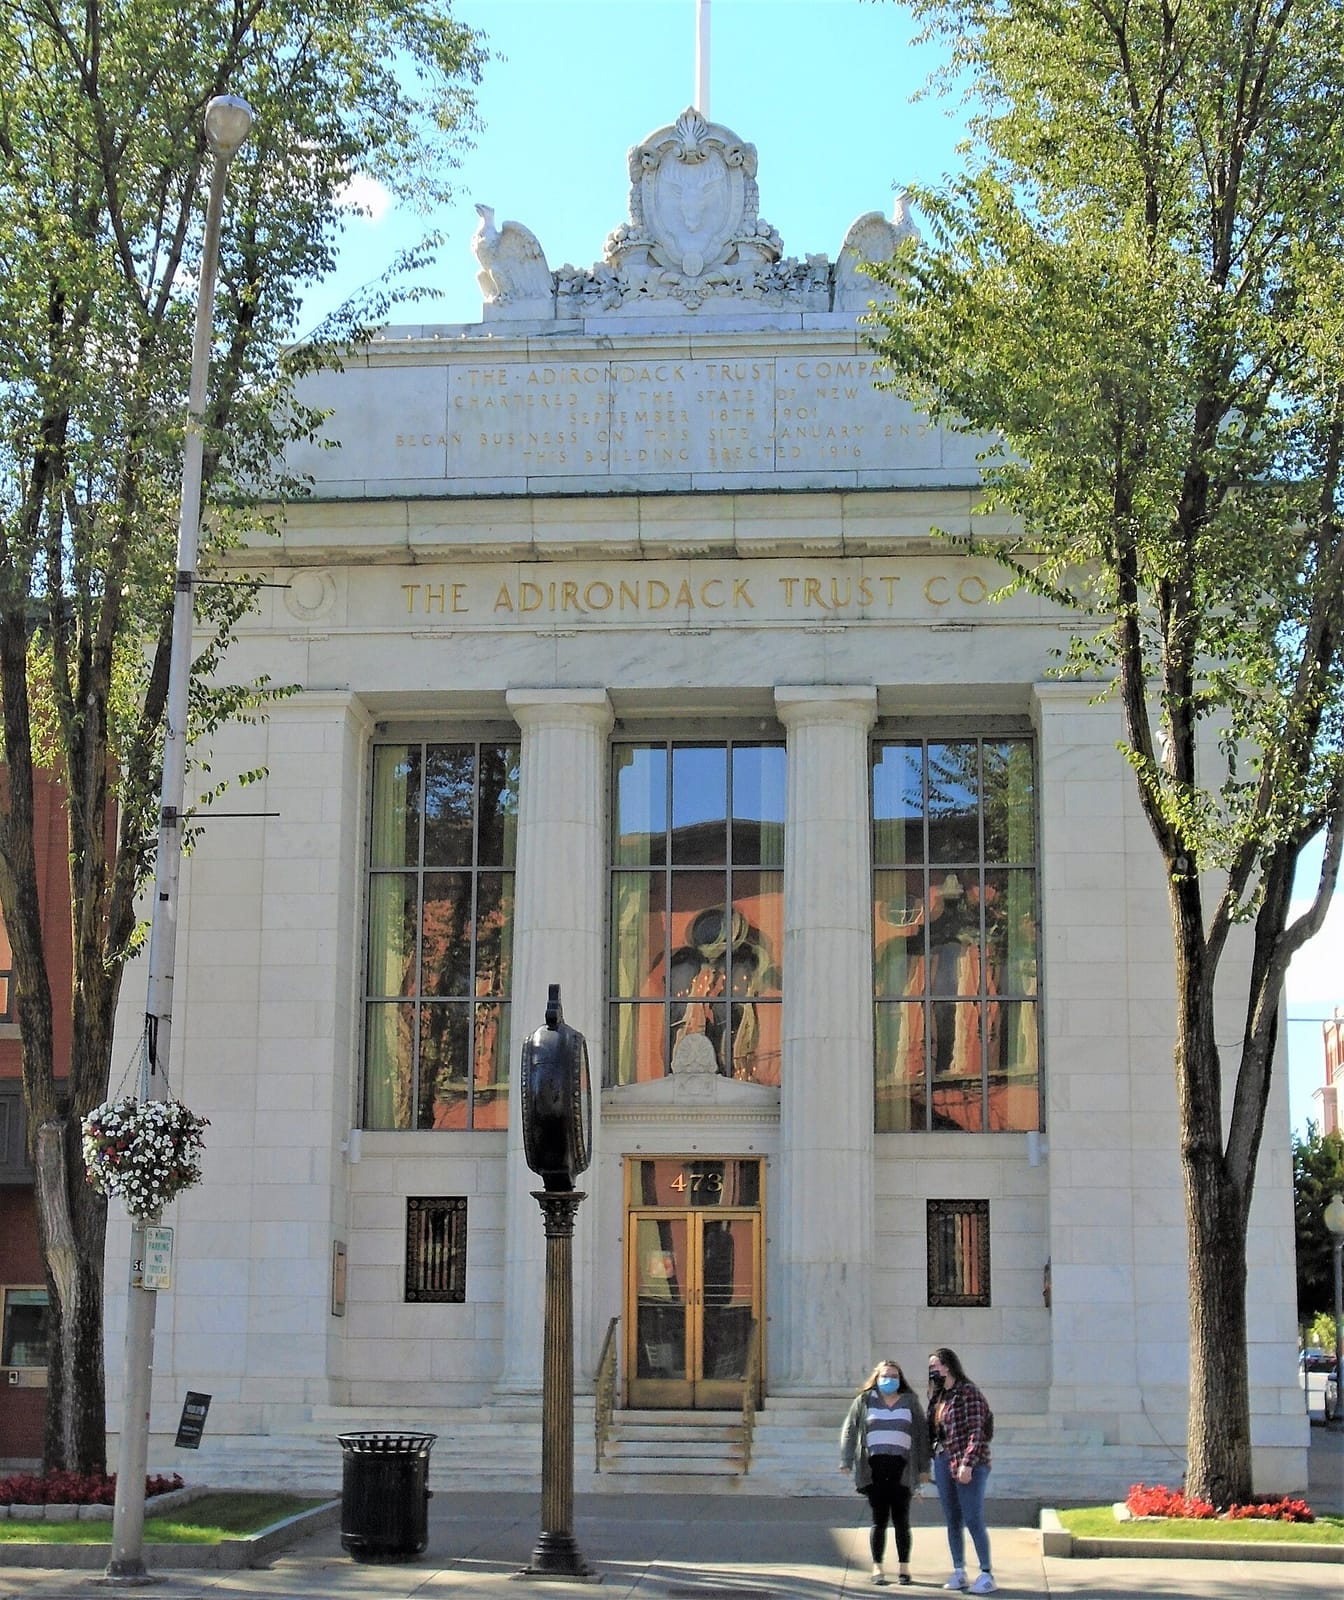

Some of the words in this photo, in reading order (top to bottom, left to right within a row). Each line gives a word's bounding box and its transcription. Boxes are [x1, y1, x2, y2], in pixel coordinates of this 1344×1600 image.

[468, 369, 508, 386] THE
[527, 366, 686, 385] ADIRONDACK
[706, 363, 775, 382] TRUST
[454, 393, 578, 409] CHARTERED
[640, 391, 673, 405] THE
[698, 389, 755, 403] STATE
[776, 388, 797, 401] OF
[816, 387, 858, 400] NEW
[569, 409, 689, 425] SEPTEMBER
[396, 432, 462, 447] BEGAN
[480, 431, 578, 445] BUSINESS
[597, 430, 624, 443] ON
[709, 427, 750, 441] SITE
[768, 425, 864, 440] JANUARY
[584, 448, 689, 463] BUILDING
[400, 583, 470, 613] THE
[494, 578, 755, 614] ADIRONDACK
[779, 576, 901, 610] TRUST
[670, 1173, 724, 1192] 473
